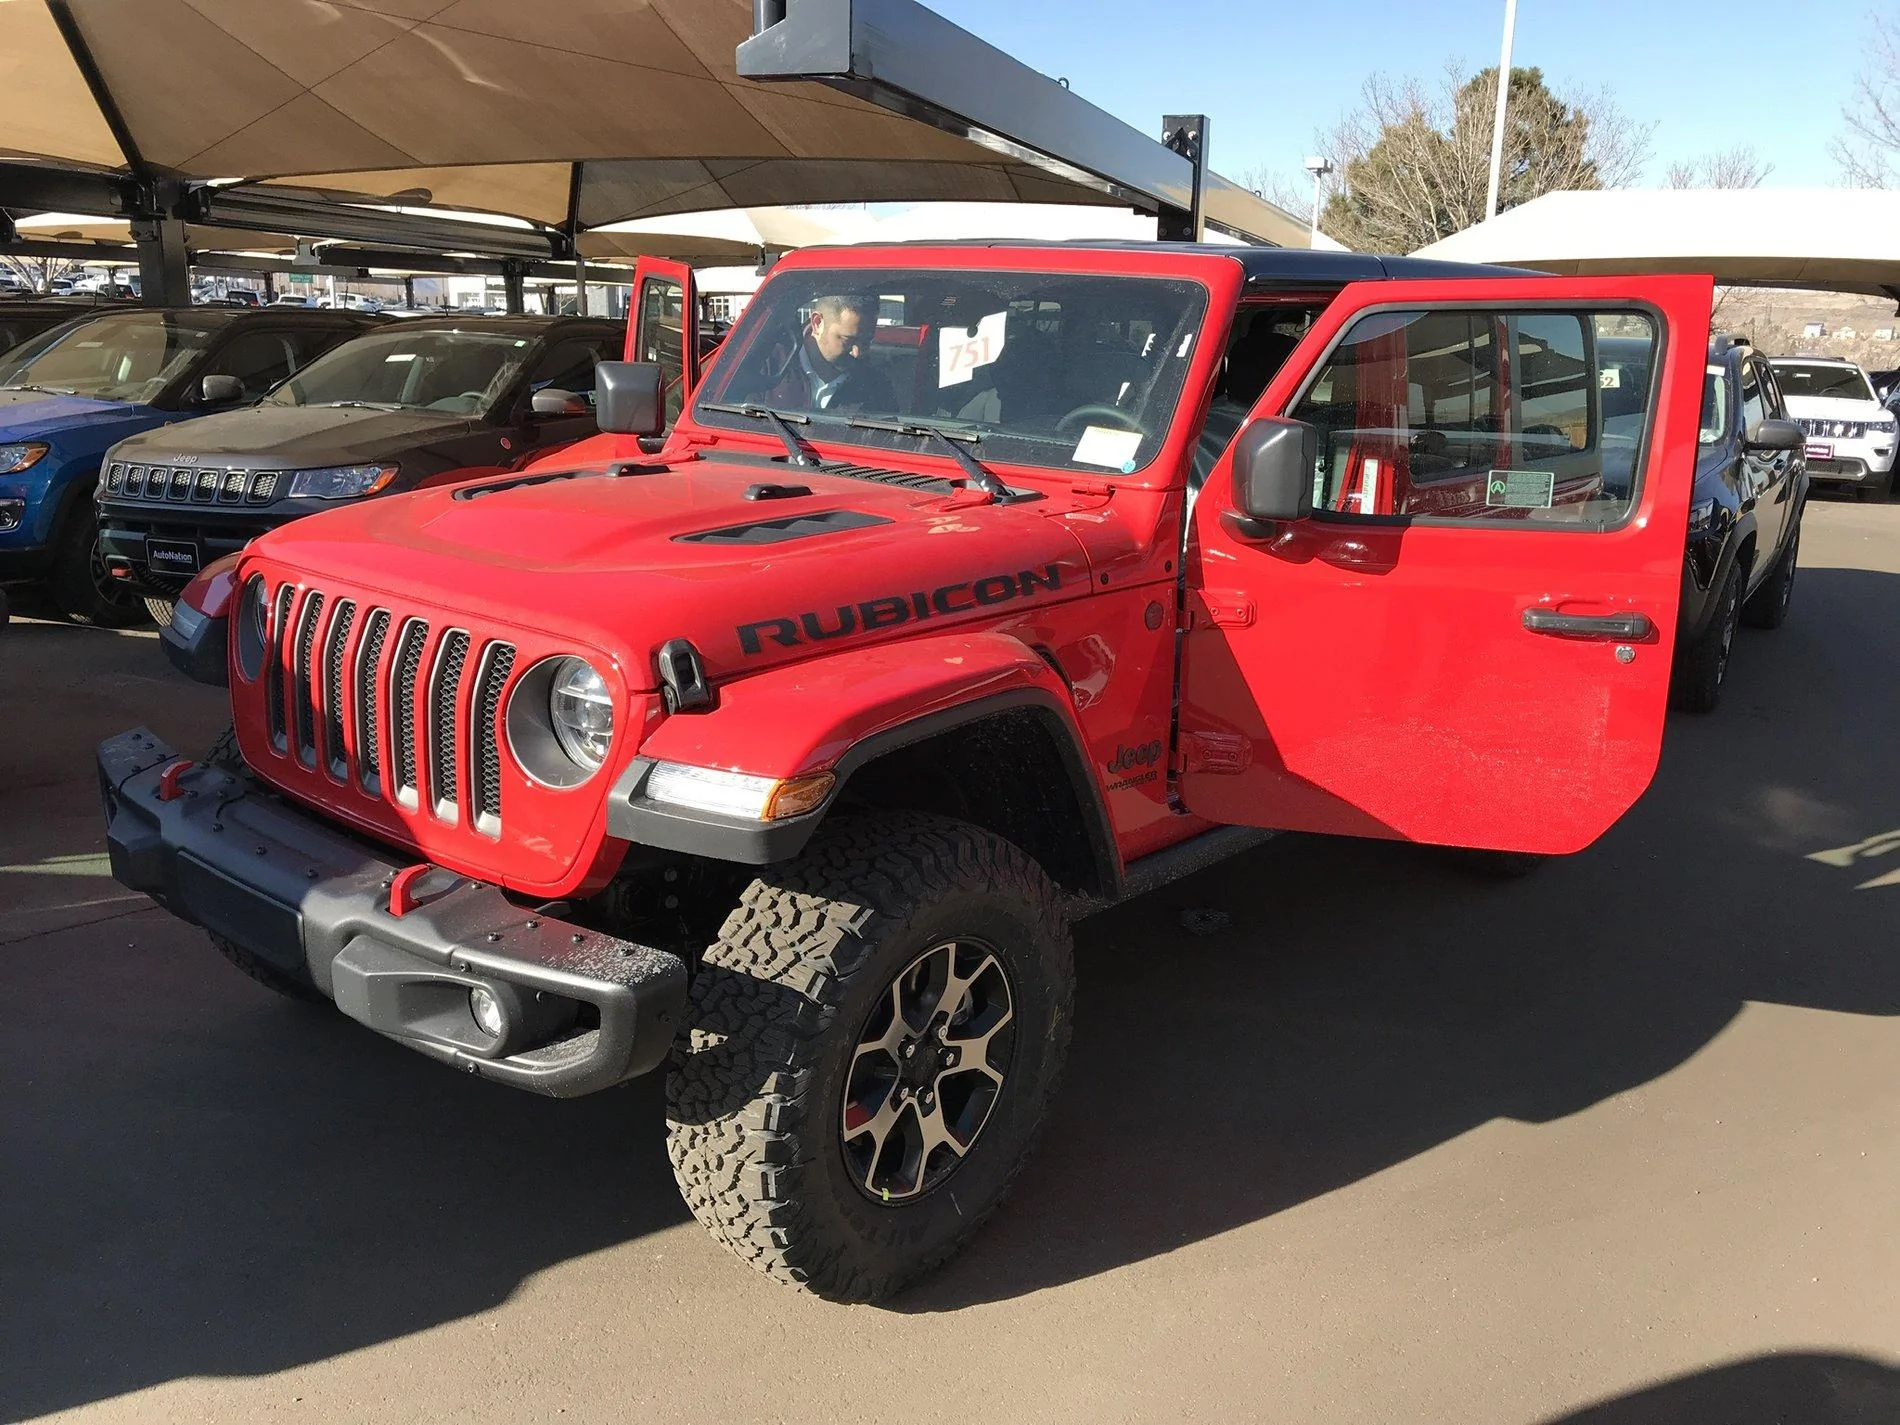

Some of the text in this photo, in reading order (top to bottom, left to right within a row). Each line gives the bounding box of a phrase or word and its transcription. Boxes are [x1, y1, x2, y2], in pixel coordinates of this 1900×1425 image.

[949, 336, 989, 372] 751
[173, 453, 199, 464] Jeep
[153, 550, 192, 563] AutoNation
[736, 563, 1061, 655] RUBICON
[1107, 739, 1162, 774] Jeep
[1106, 770, 1158, 791] WRANGLER
